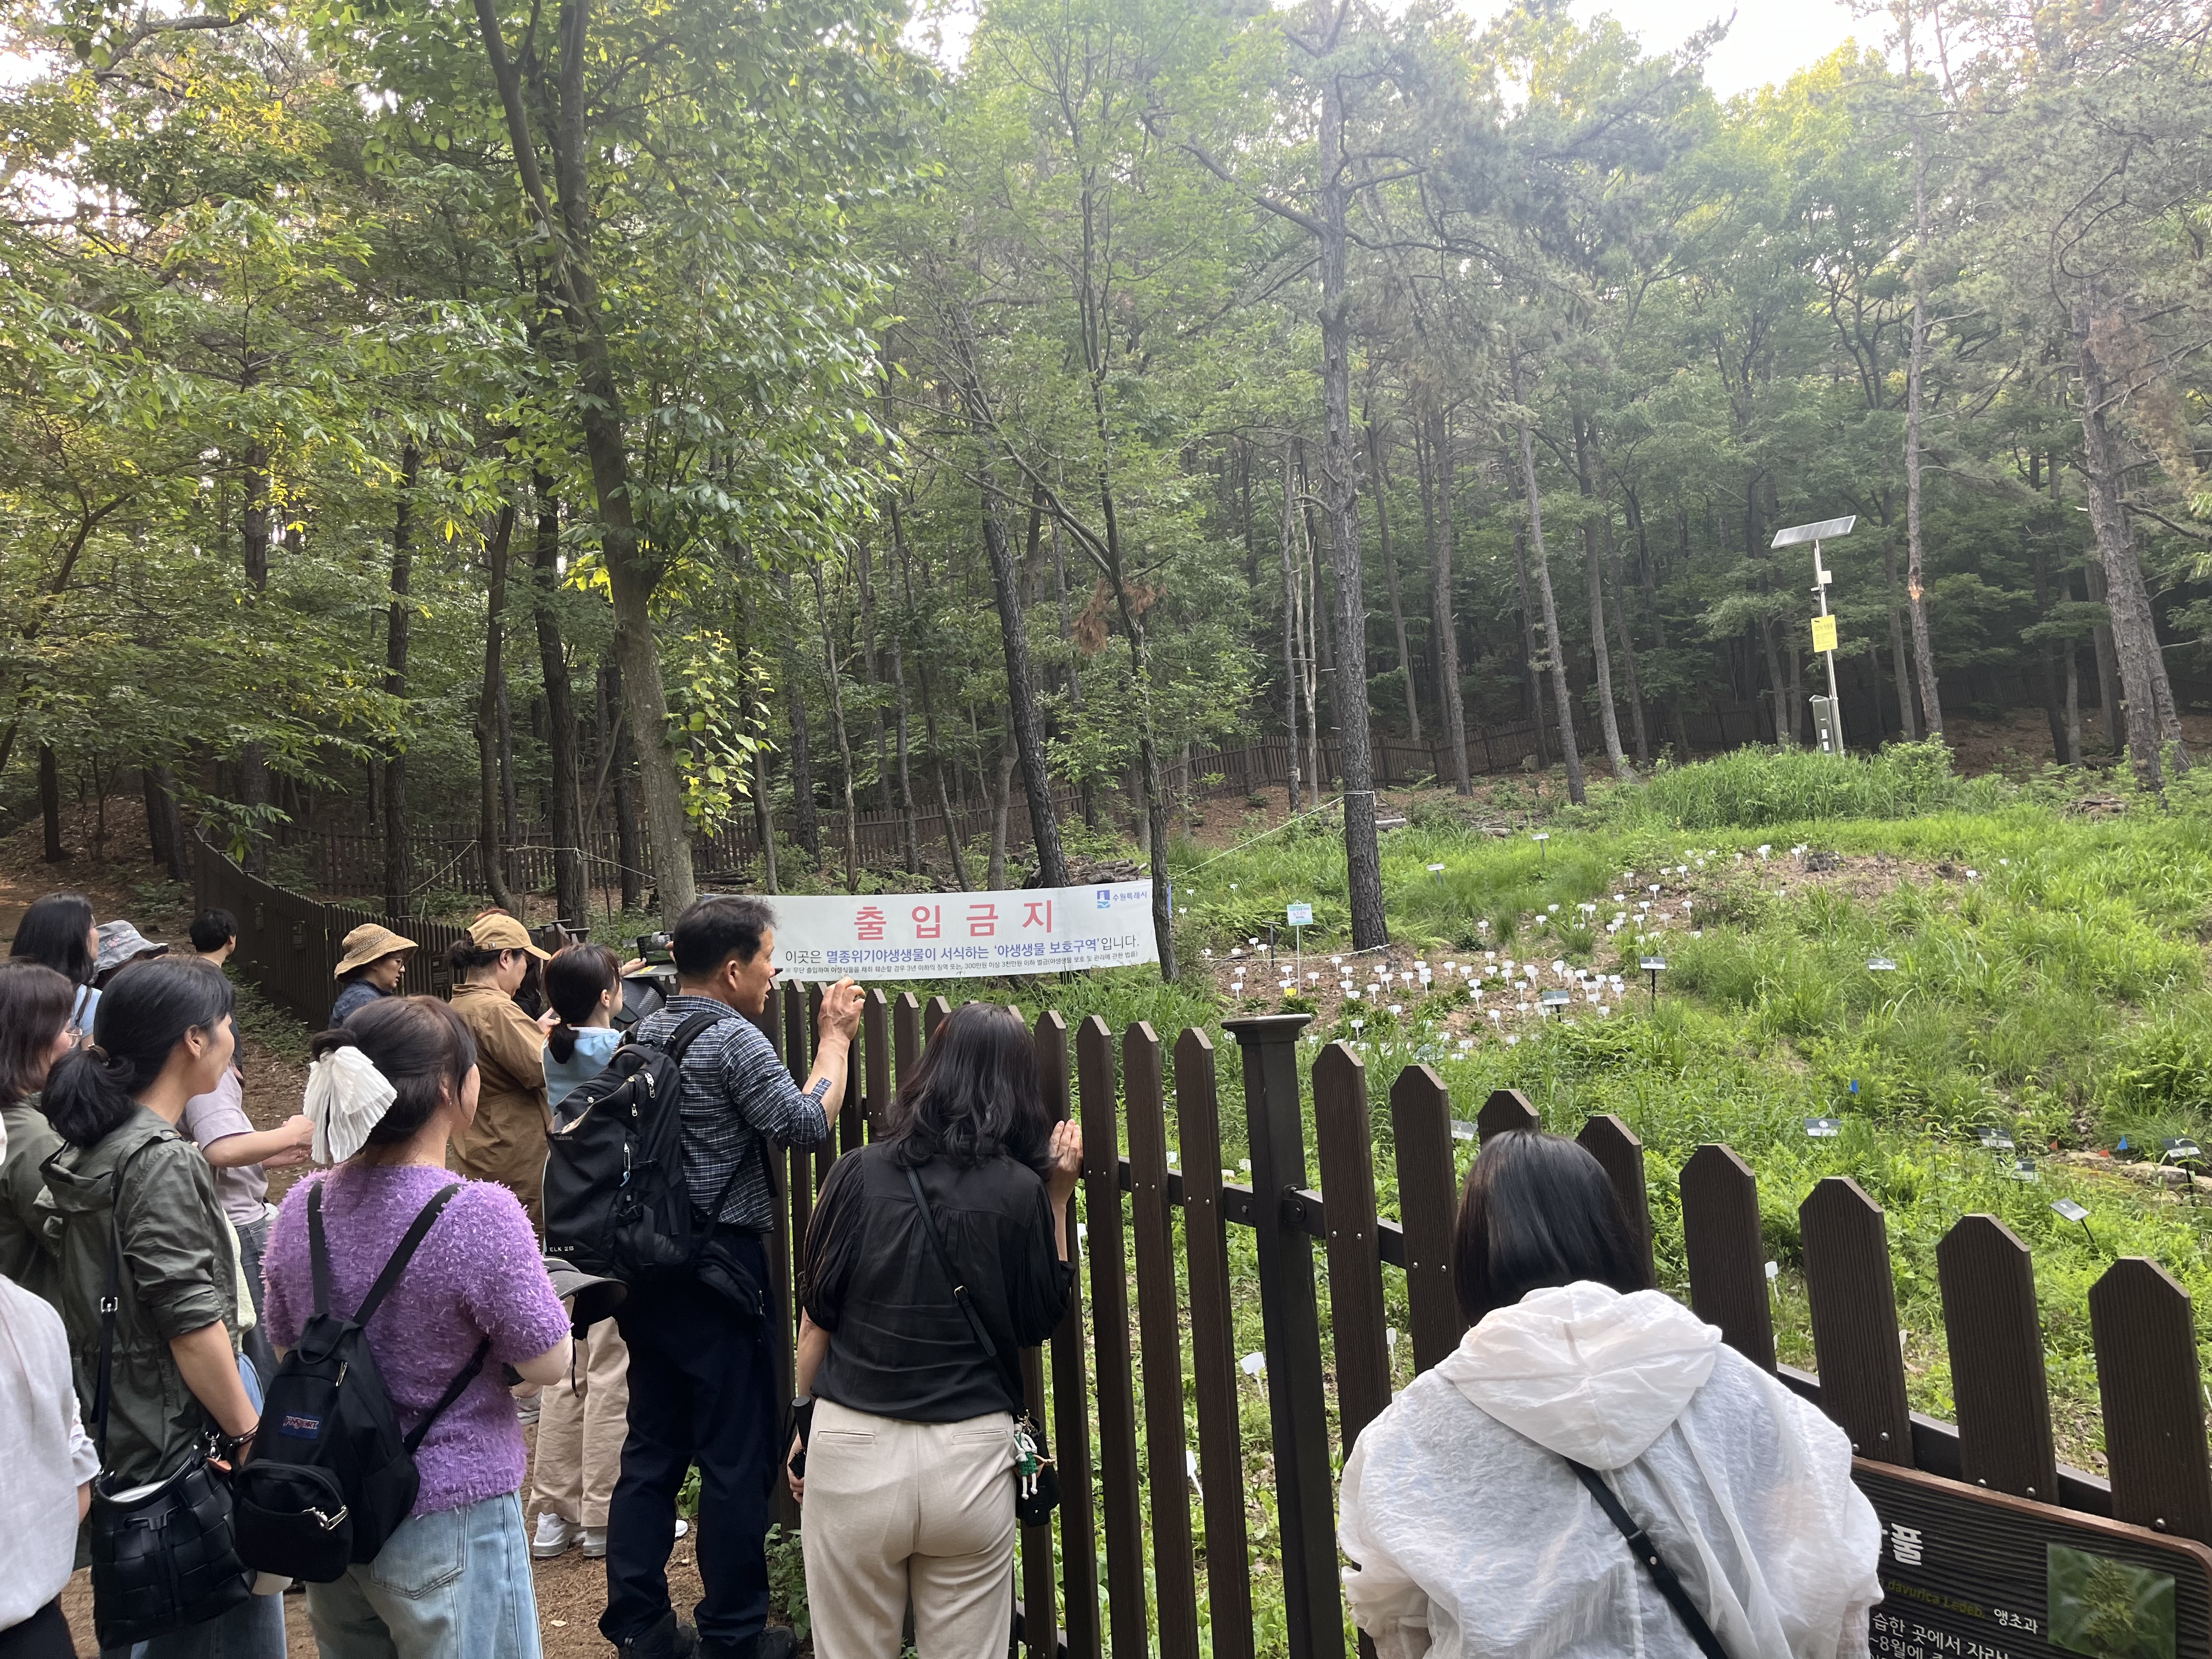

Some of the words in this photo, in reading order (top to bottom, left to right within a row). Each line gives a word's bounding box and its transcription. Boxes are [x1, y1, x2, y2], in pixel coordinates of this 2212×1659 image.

[1113, 890, 1147, 901] 수원특례시
[854, 906, 887, 940] 출
[911, 905, 940, 939] 입
[966, 904, 998, 936] 금
[1022, 900, 1052, 933] 지
[786, 950, 822, 964] 이곳은
[827, 947, 936, 963] 멸종위기야생생물이
[940, 946, 989, 960] 서식하는
[1993, 1609, 2038, 1635] 앵초과
[1872, 1612, 1906, 1638] 습한
[1912, 1624, 1960, 1656] 곳에서
[1967, 1641, 2009, 1659] 자라
